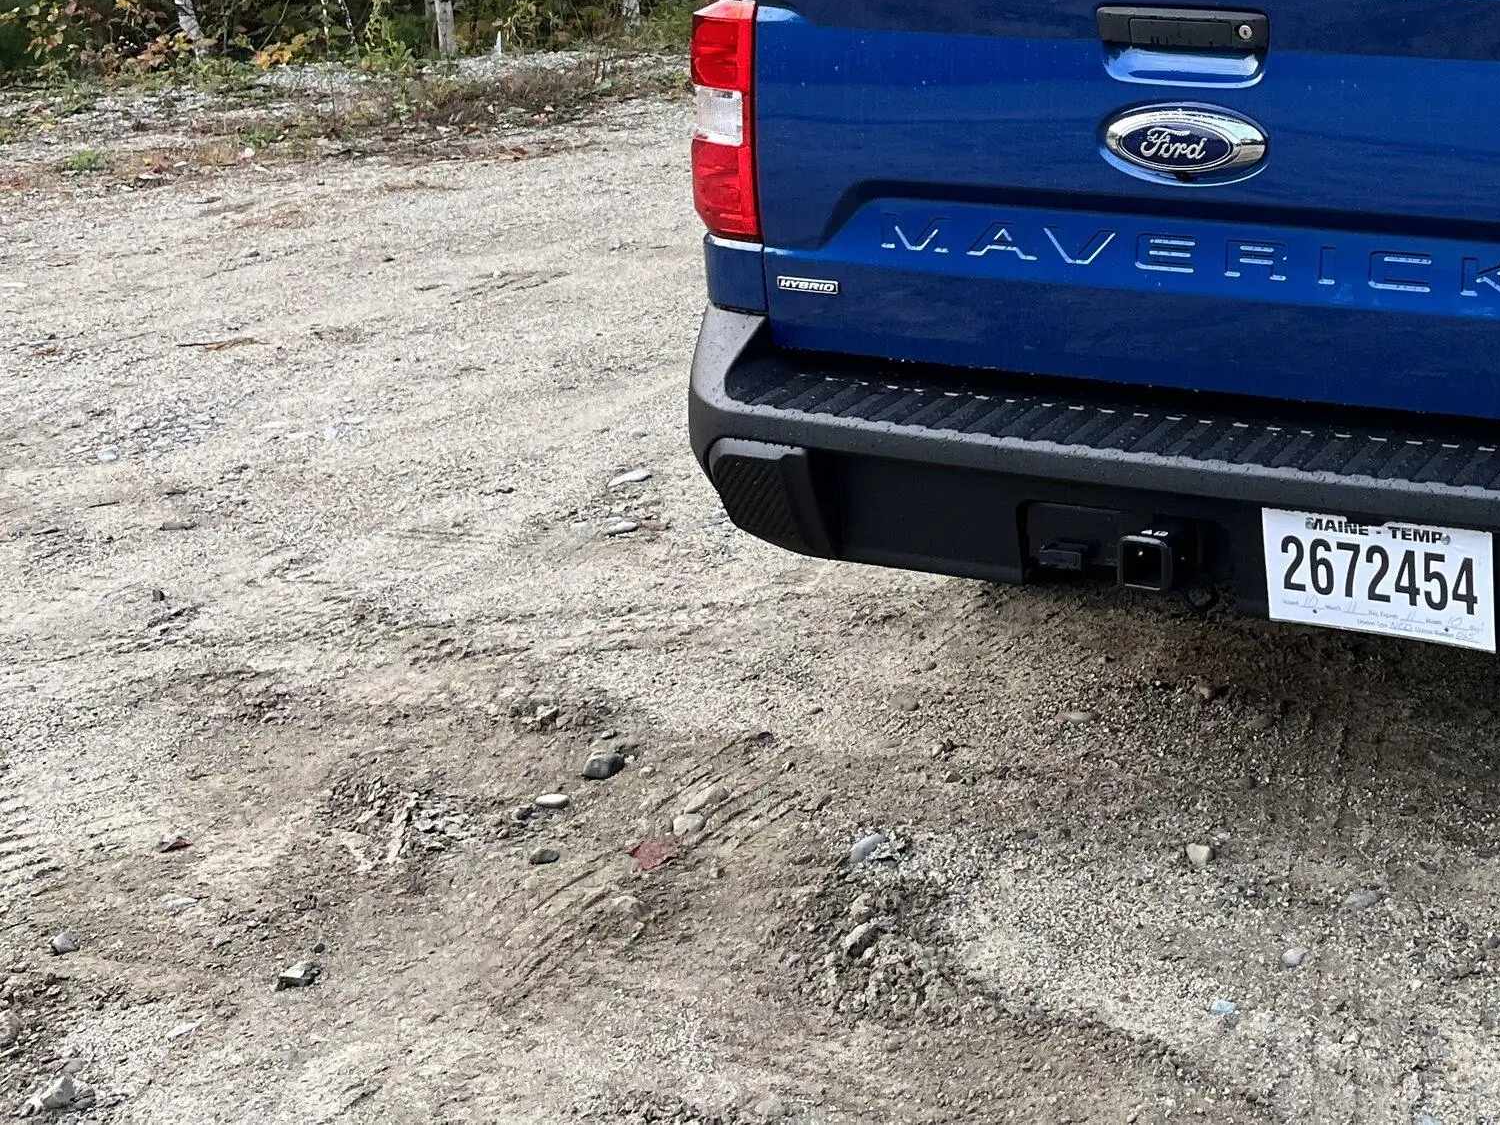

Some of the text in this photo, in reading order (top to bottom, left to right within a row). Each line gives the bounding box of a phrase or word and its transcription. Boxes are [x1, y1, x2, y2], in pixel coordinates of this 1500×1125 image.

[1140, 127, 1207, 160] Ford
[780, 279, 834, 292] HYBRID
[1281, 535, 1478, 615] 2672454
